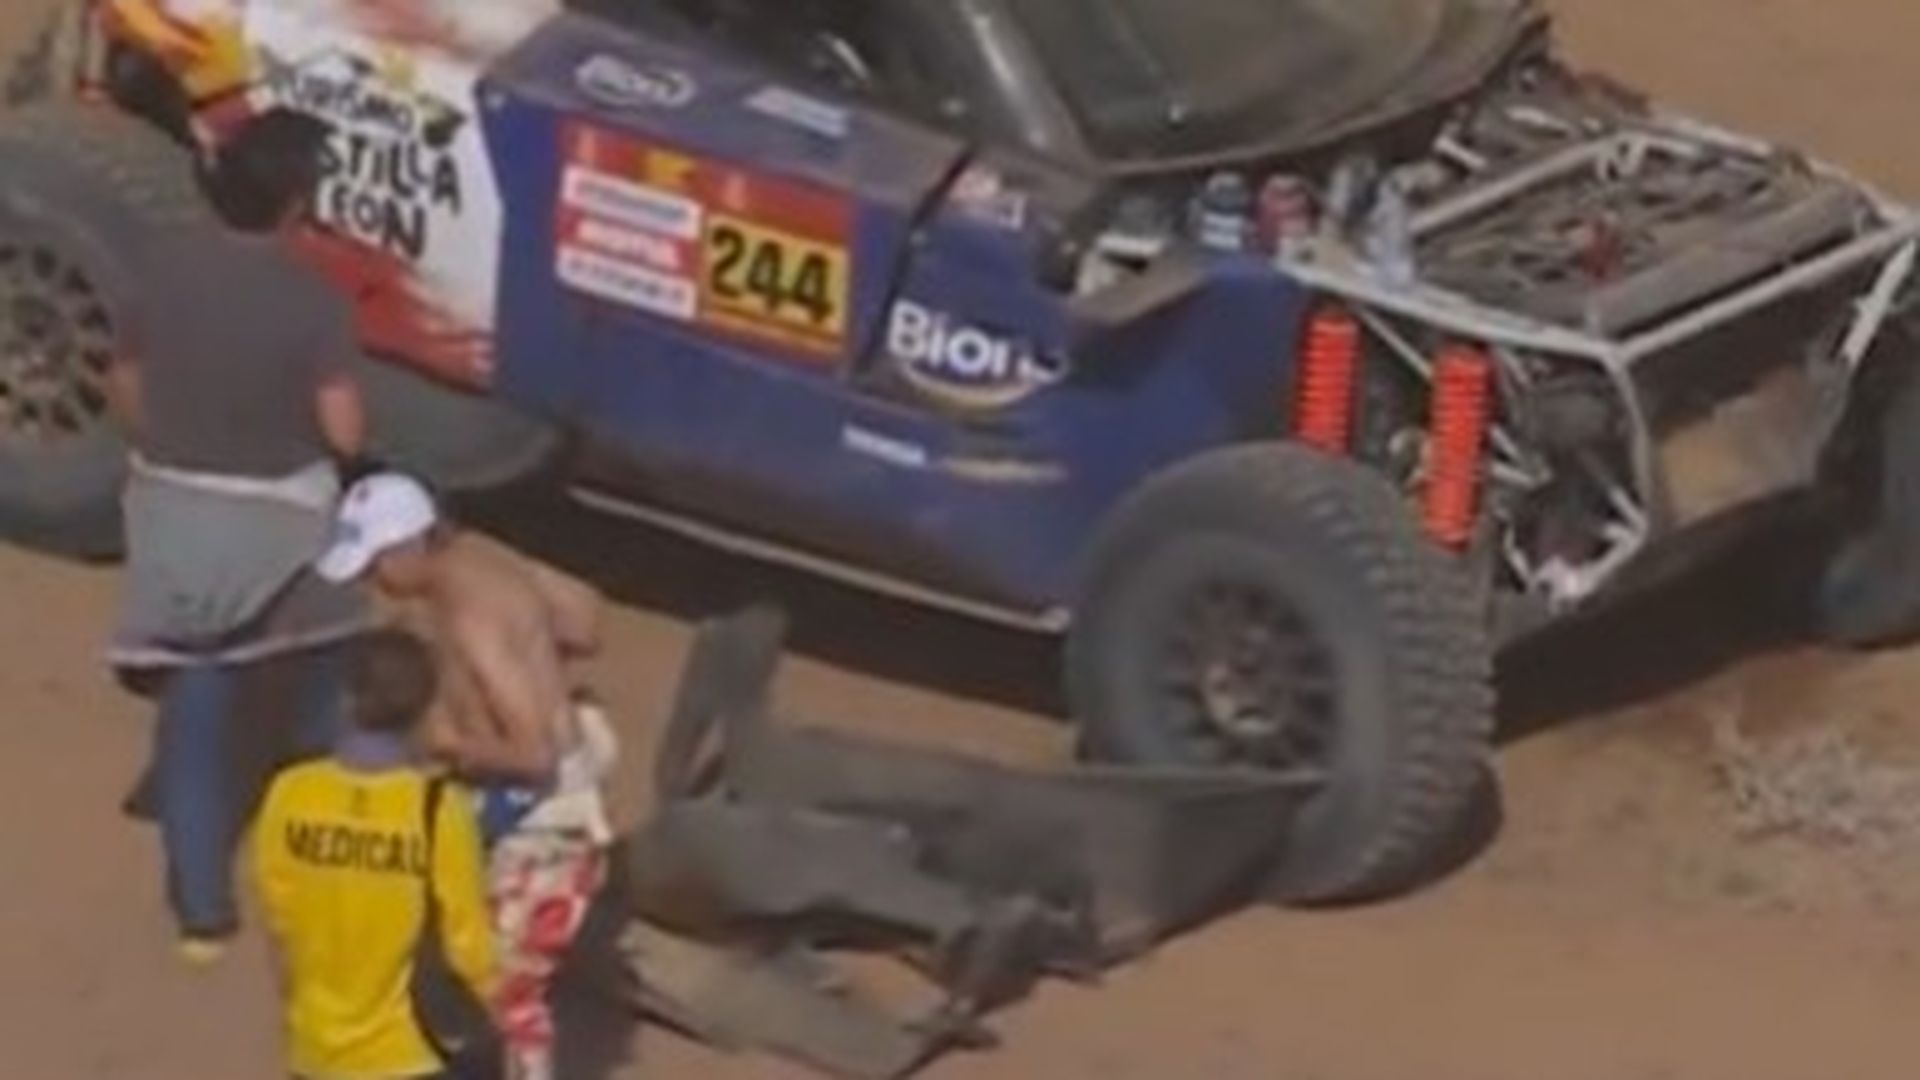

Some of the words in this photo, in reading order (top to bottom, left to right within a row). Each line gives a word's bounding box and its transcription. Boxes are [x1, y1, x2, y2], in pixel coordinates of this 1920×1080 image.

[321, 124, 462, 216] STILLA
[330, 183, 426, 259] EON
[709, 224, 834, 323] 244
[284, 818, 429, 877] MEDICAL
